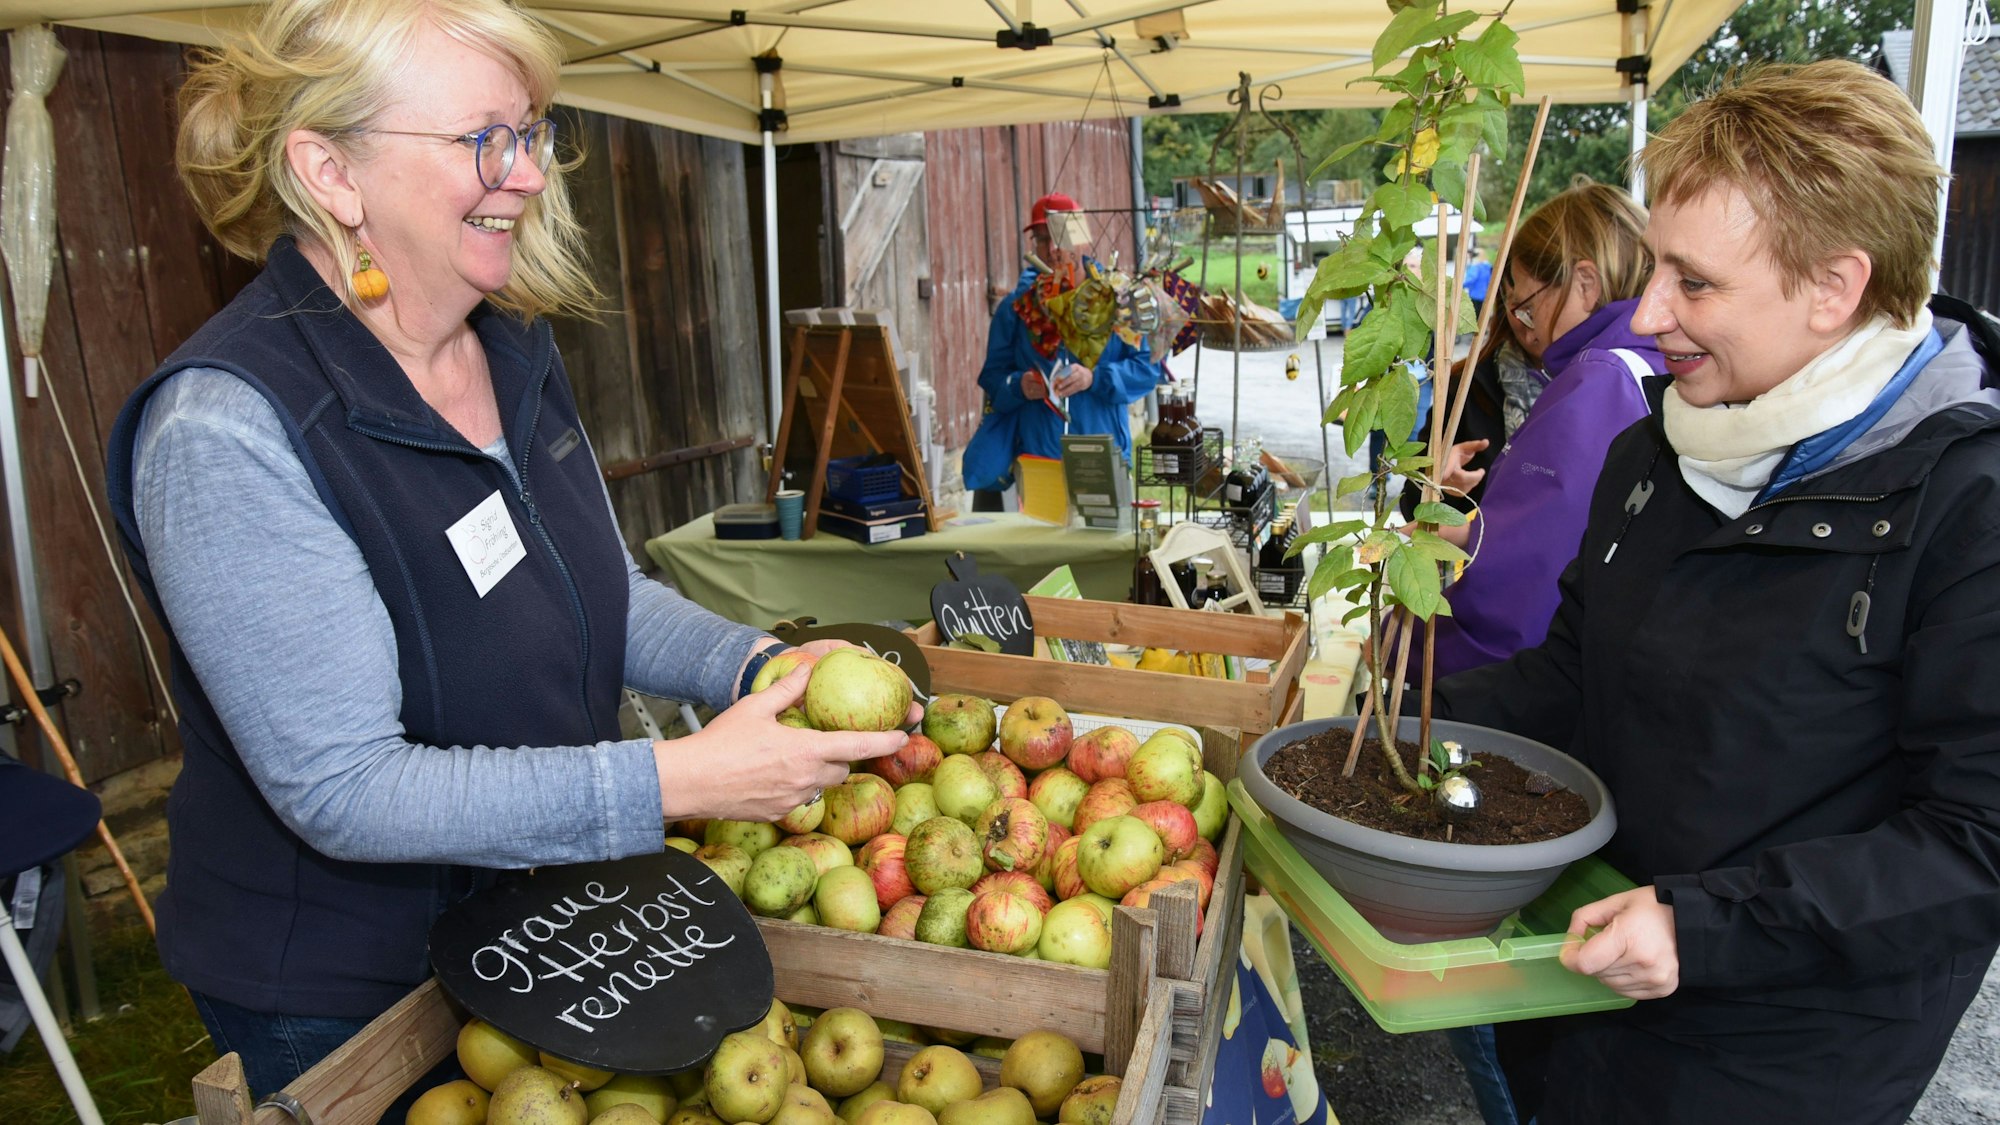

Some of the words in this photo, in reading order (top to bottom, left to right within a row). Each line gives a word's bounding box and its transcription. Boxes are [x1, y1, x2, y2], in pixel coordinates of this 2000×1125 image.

[941, 586, 1033, 641] Quitten
[472, 881, 629, 993] graue
[555, 925, 736, 1033] renette
